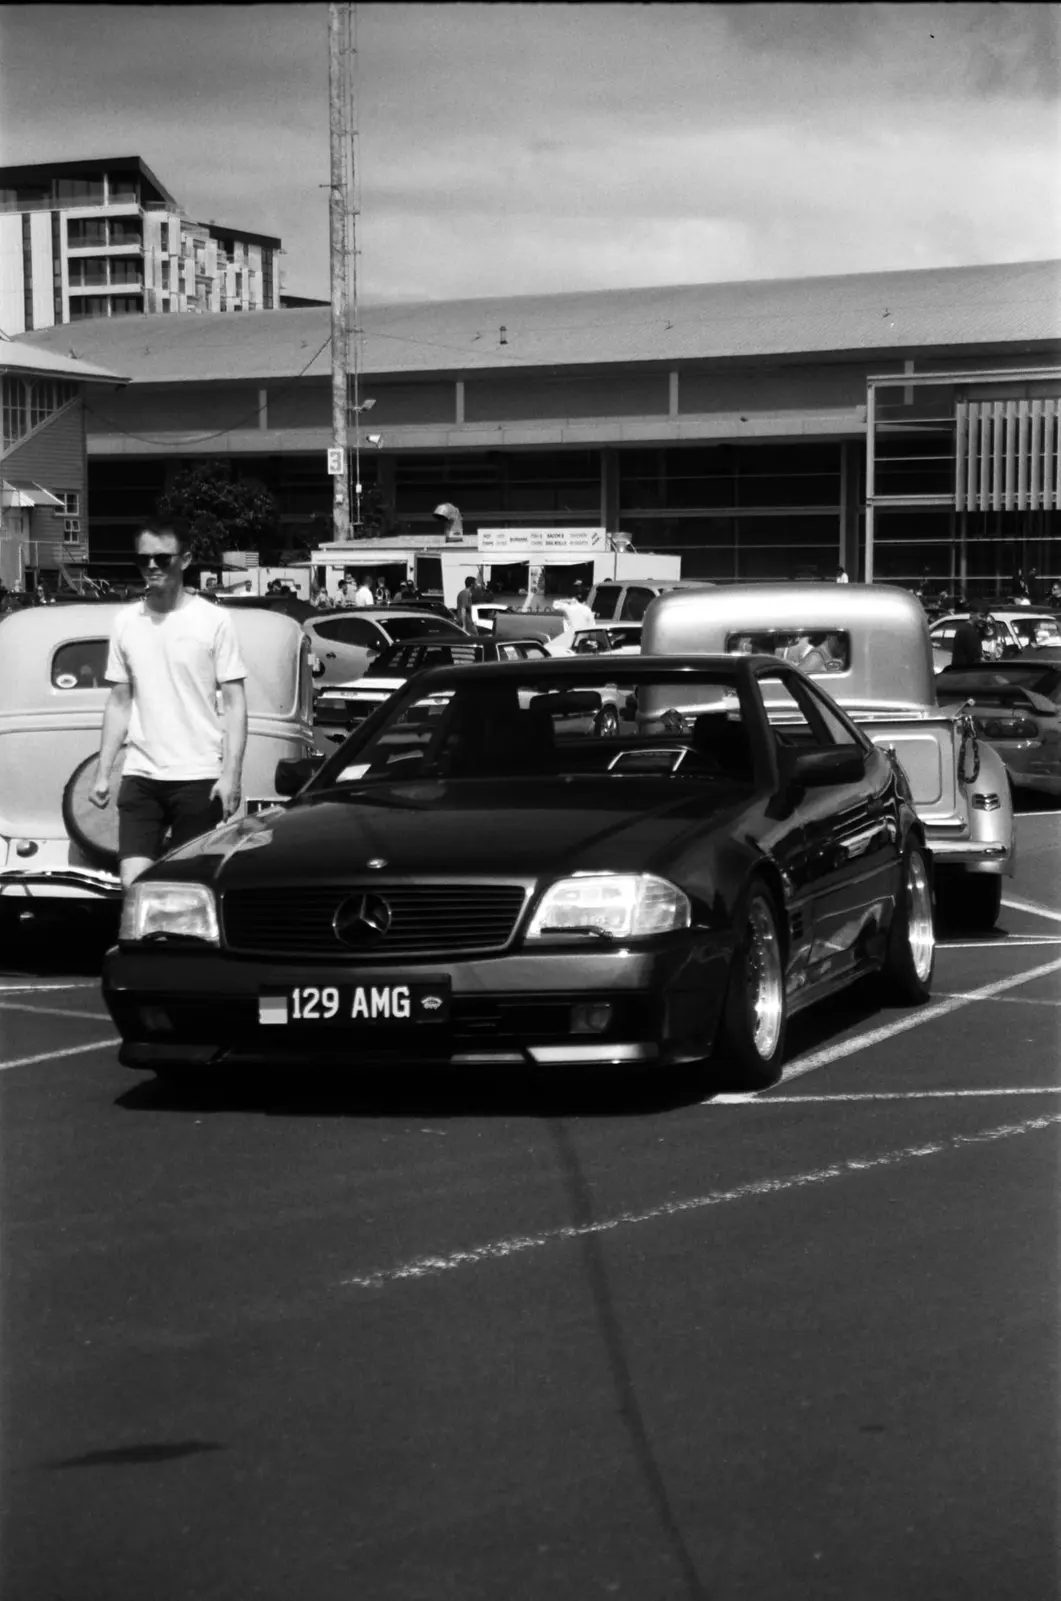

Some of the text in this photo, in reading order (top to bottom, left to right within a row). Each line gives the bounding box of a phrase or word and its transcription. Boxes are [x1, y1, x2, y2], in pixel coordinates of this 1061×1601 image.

[330, 451, 341, 472] 3
[292, 986, 410, 1019] 129 AMG
